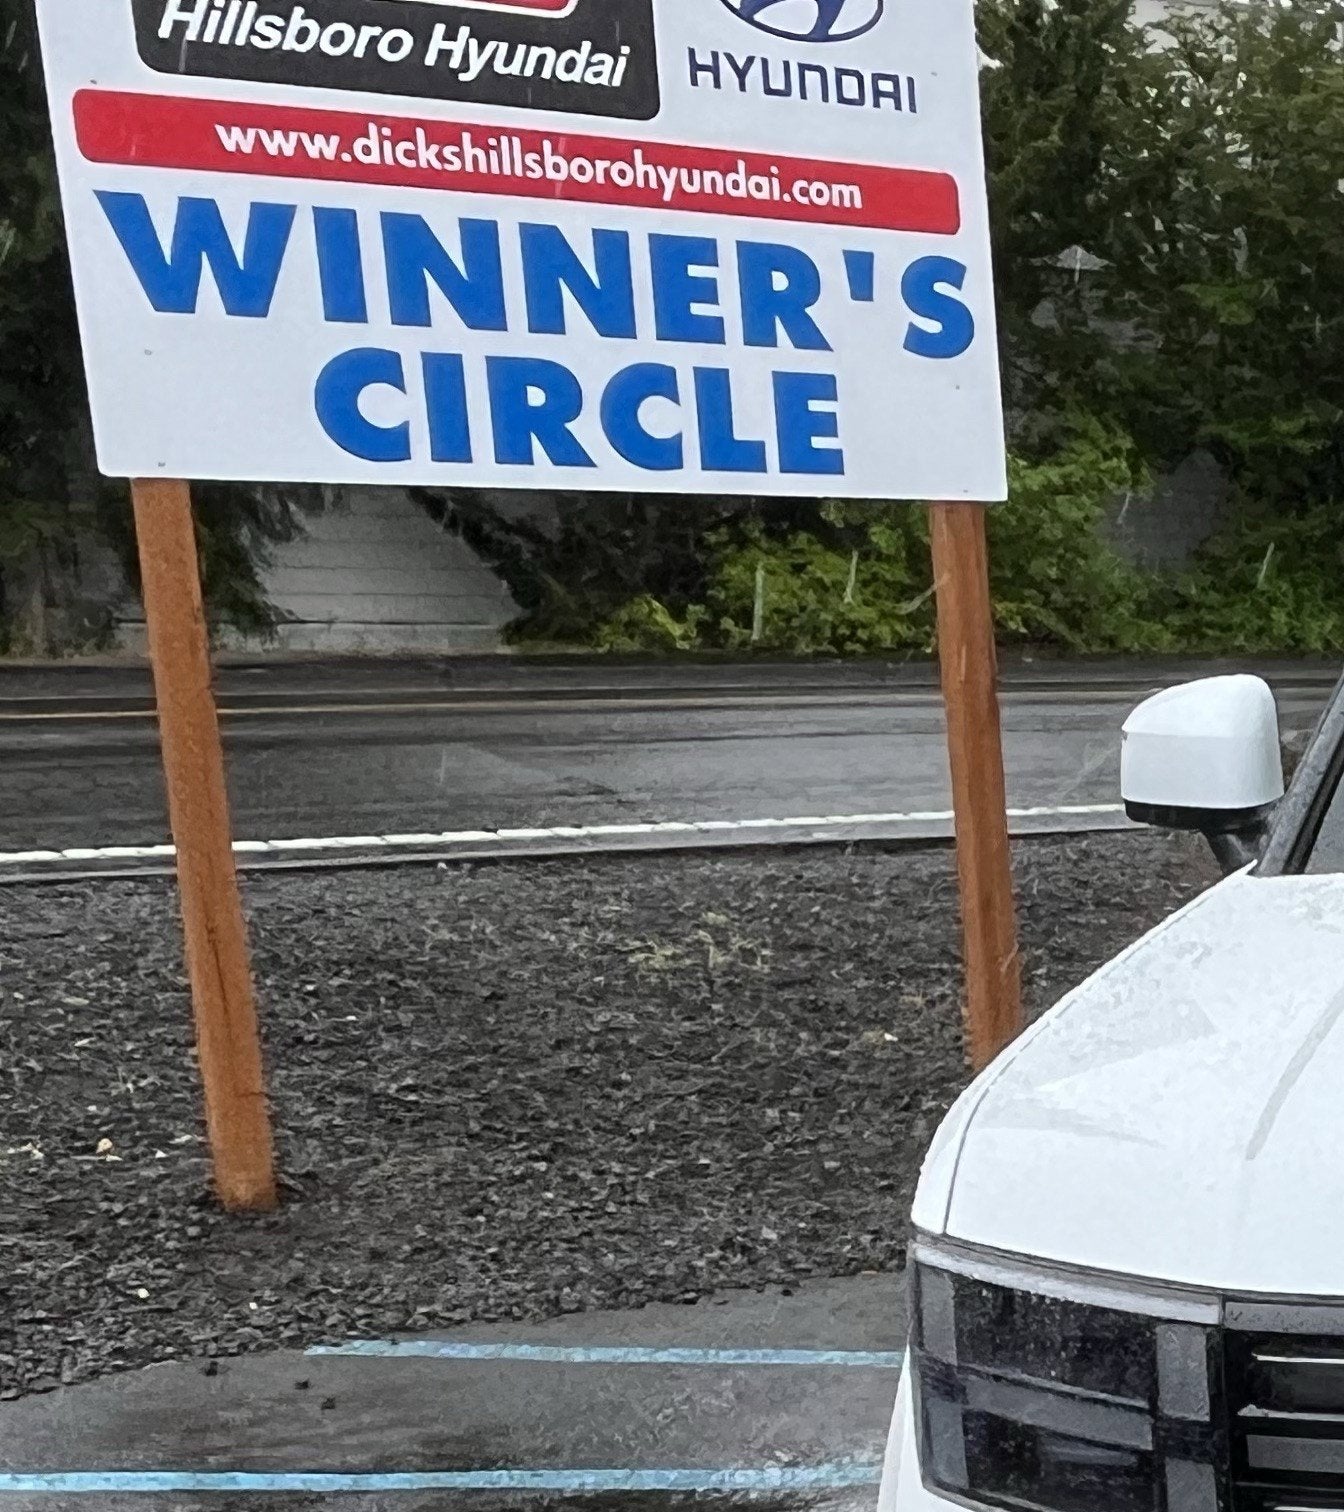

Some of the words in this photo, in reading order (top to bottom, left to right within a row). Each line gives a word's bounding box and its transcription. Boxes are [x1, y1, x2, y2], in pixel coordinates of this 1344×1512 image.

[157, 0, 414, 62] Hillsboro
[424, 22, 631, 87] Hyundai
[688, 47, 917, 114] HYUNDAI
[213, 121, 864, 210] www.dickshillsborohyundai.com
[97, 191, 974, 360] WINNER'S
[314, 346, 844, 476] CIRCLE
